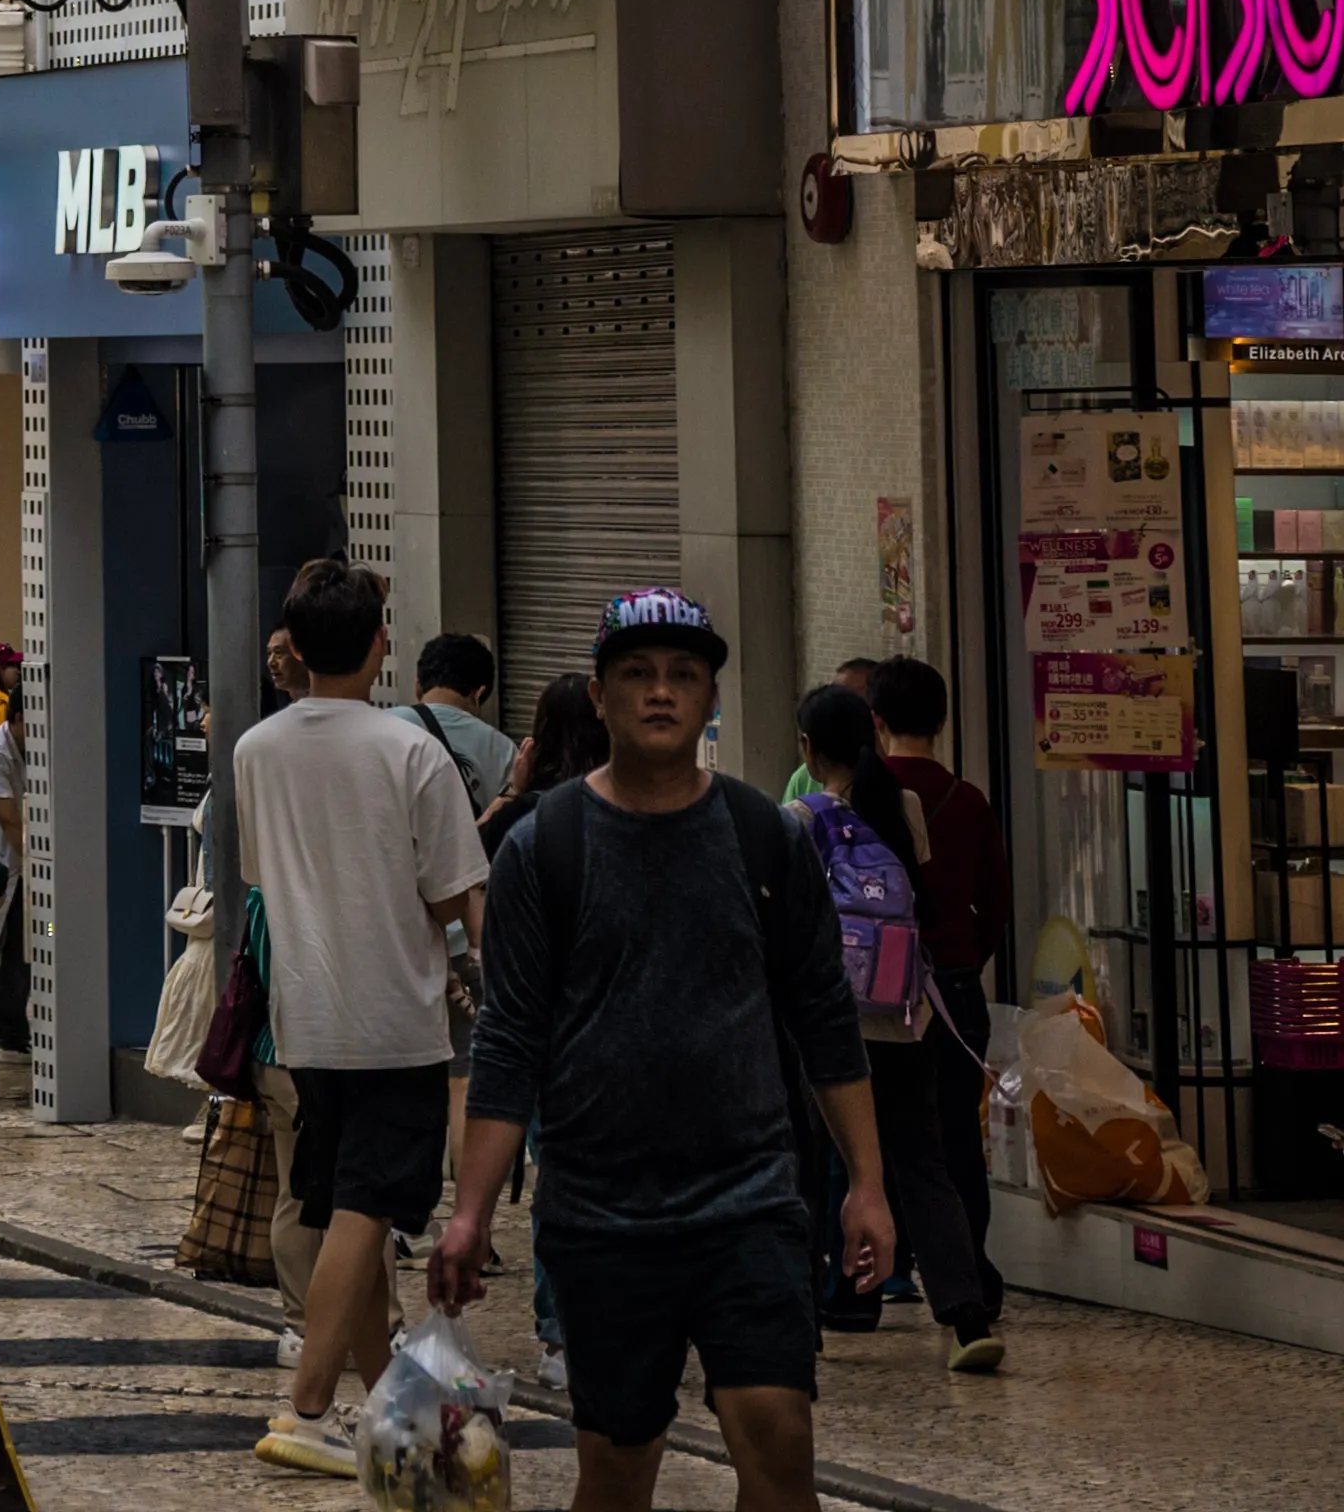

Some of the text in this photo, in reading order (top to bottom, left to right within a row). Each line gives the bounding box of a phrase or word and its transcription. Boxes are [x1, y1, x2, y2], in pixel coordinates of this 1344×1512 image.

[55, 144, 154, 255] MLB
[1248, 345, 1319, 361] Elizabeth
[117, 413, 159, 427] Chubb
[1028, 539, 1097, 553] WELLNESS
